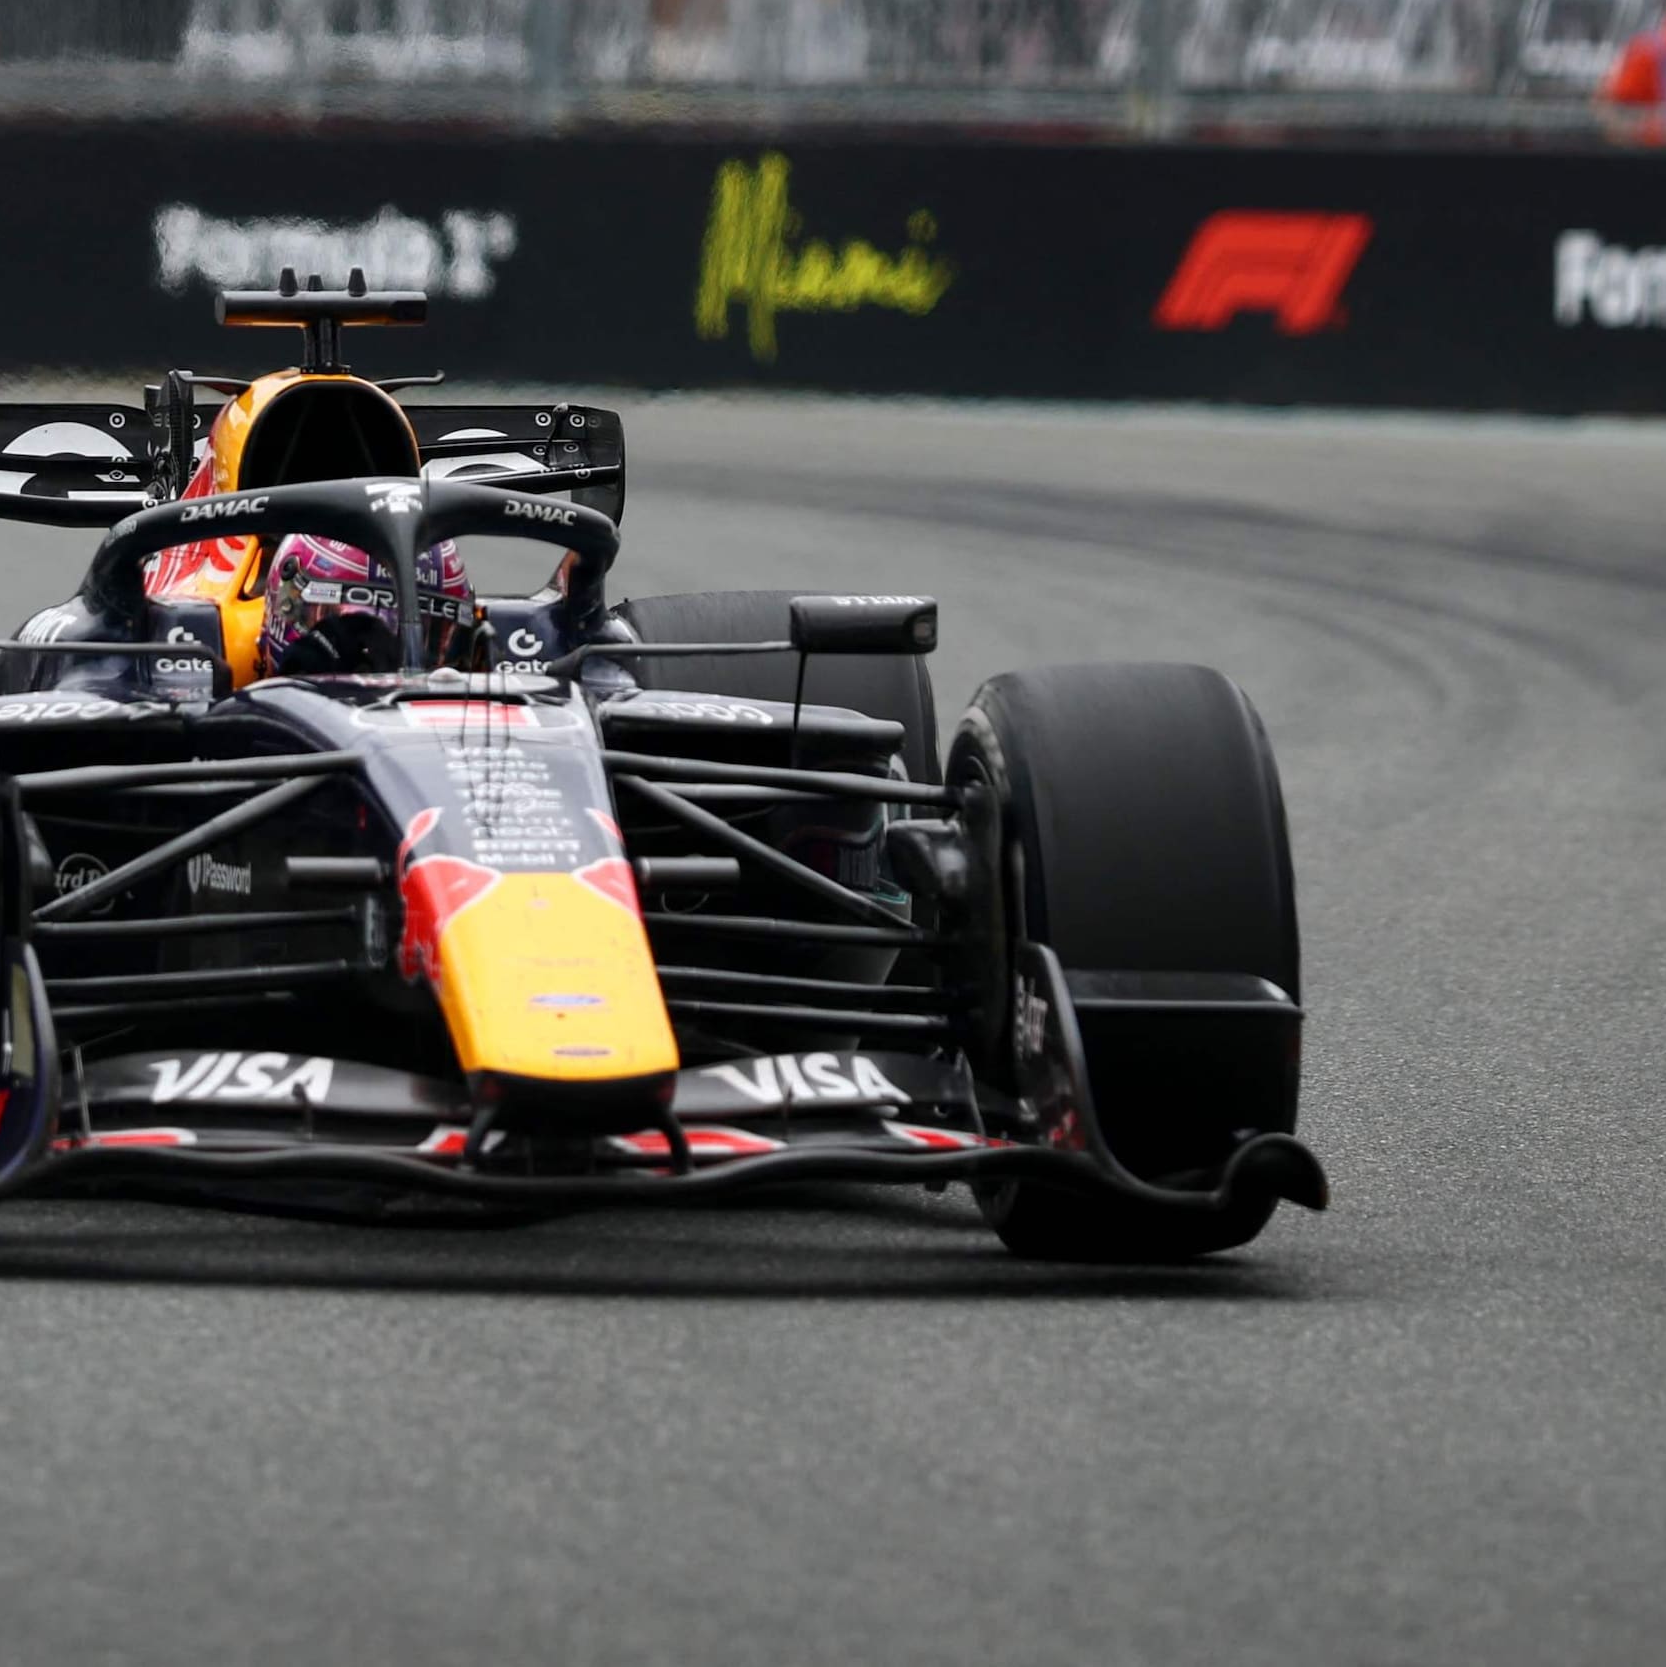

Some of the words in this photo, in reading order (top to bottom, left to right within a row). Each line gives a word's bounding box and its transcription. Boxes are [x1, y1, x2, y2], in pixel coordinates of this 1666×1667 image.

[180, 495, 270, 522] DAMAC
[503, 499, 578, 526] DAMAC
[346, 586, 456, 618] ORCLE
[155, 657, 214, 672] Gate
[148, 1051, 334, 1104] VISA
[698, 1052, 912, 1105] VISA
